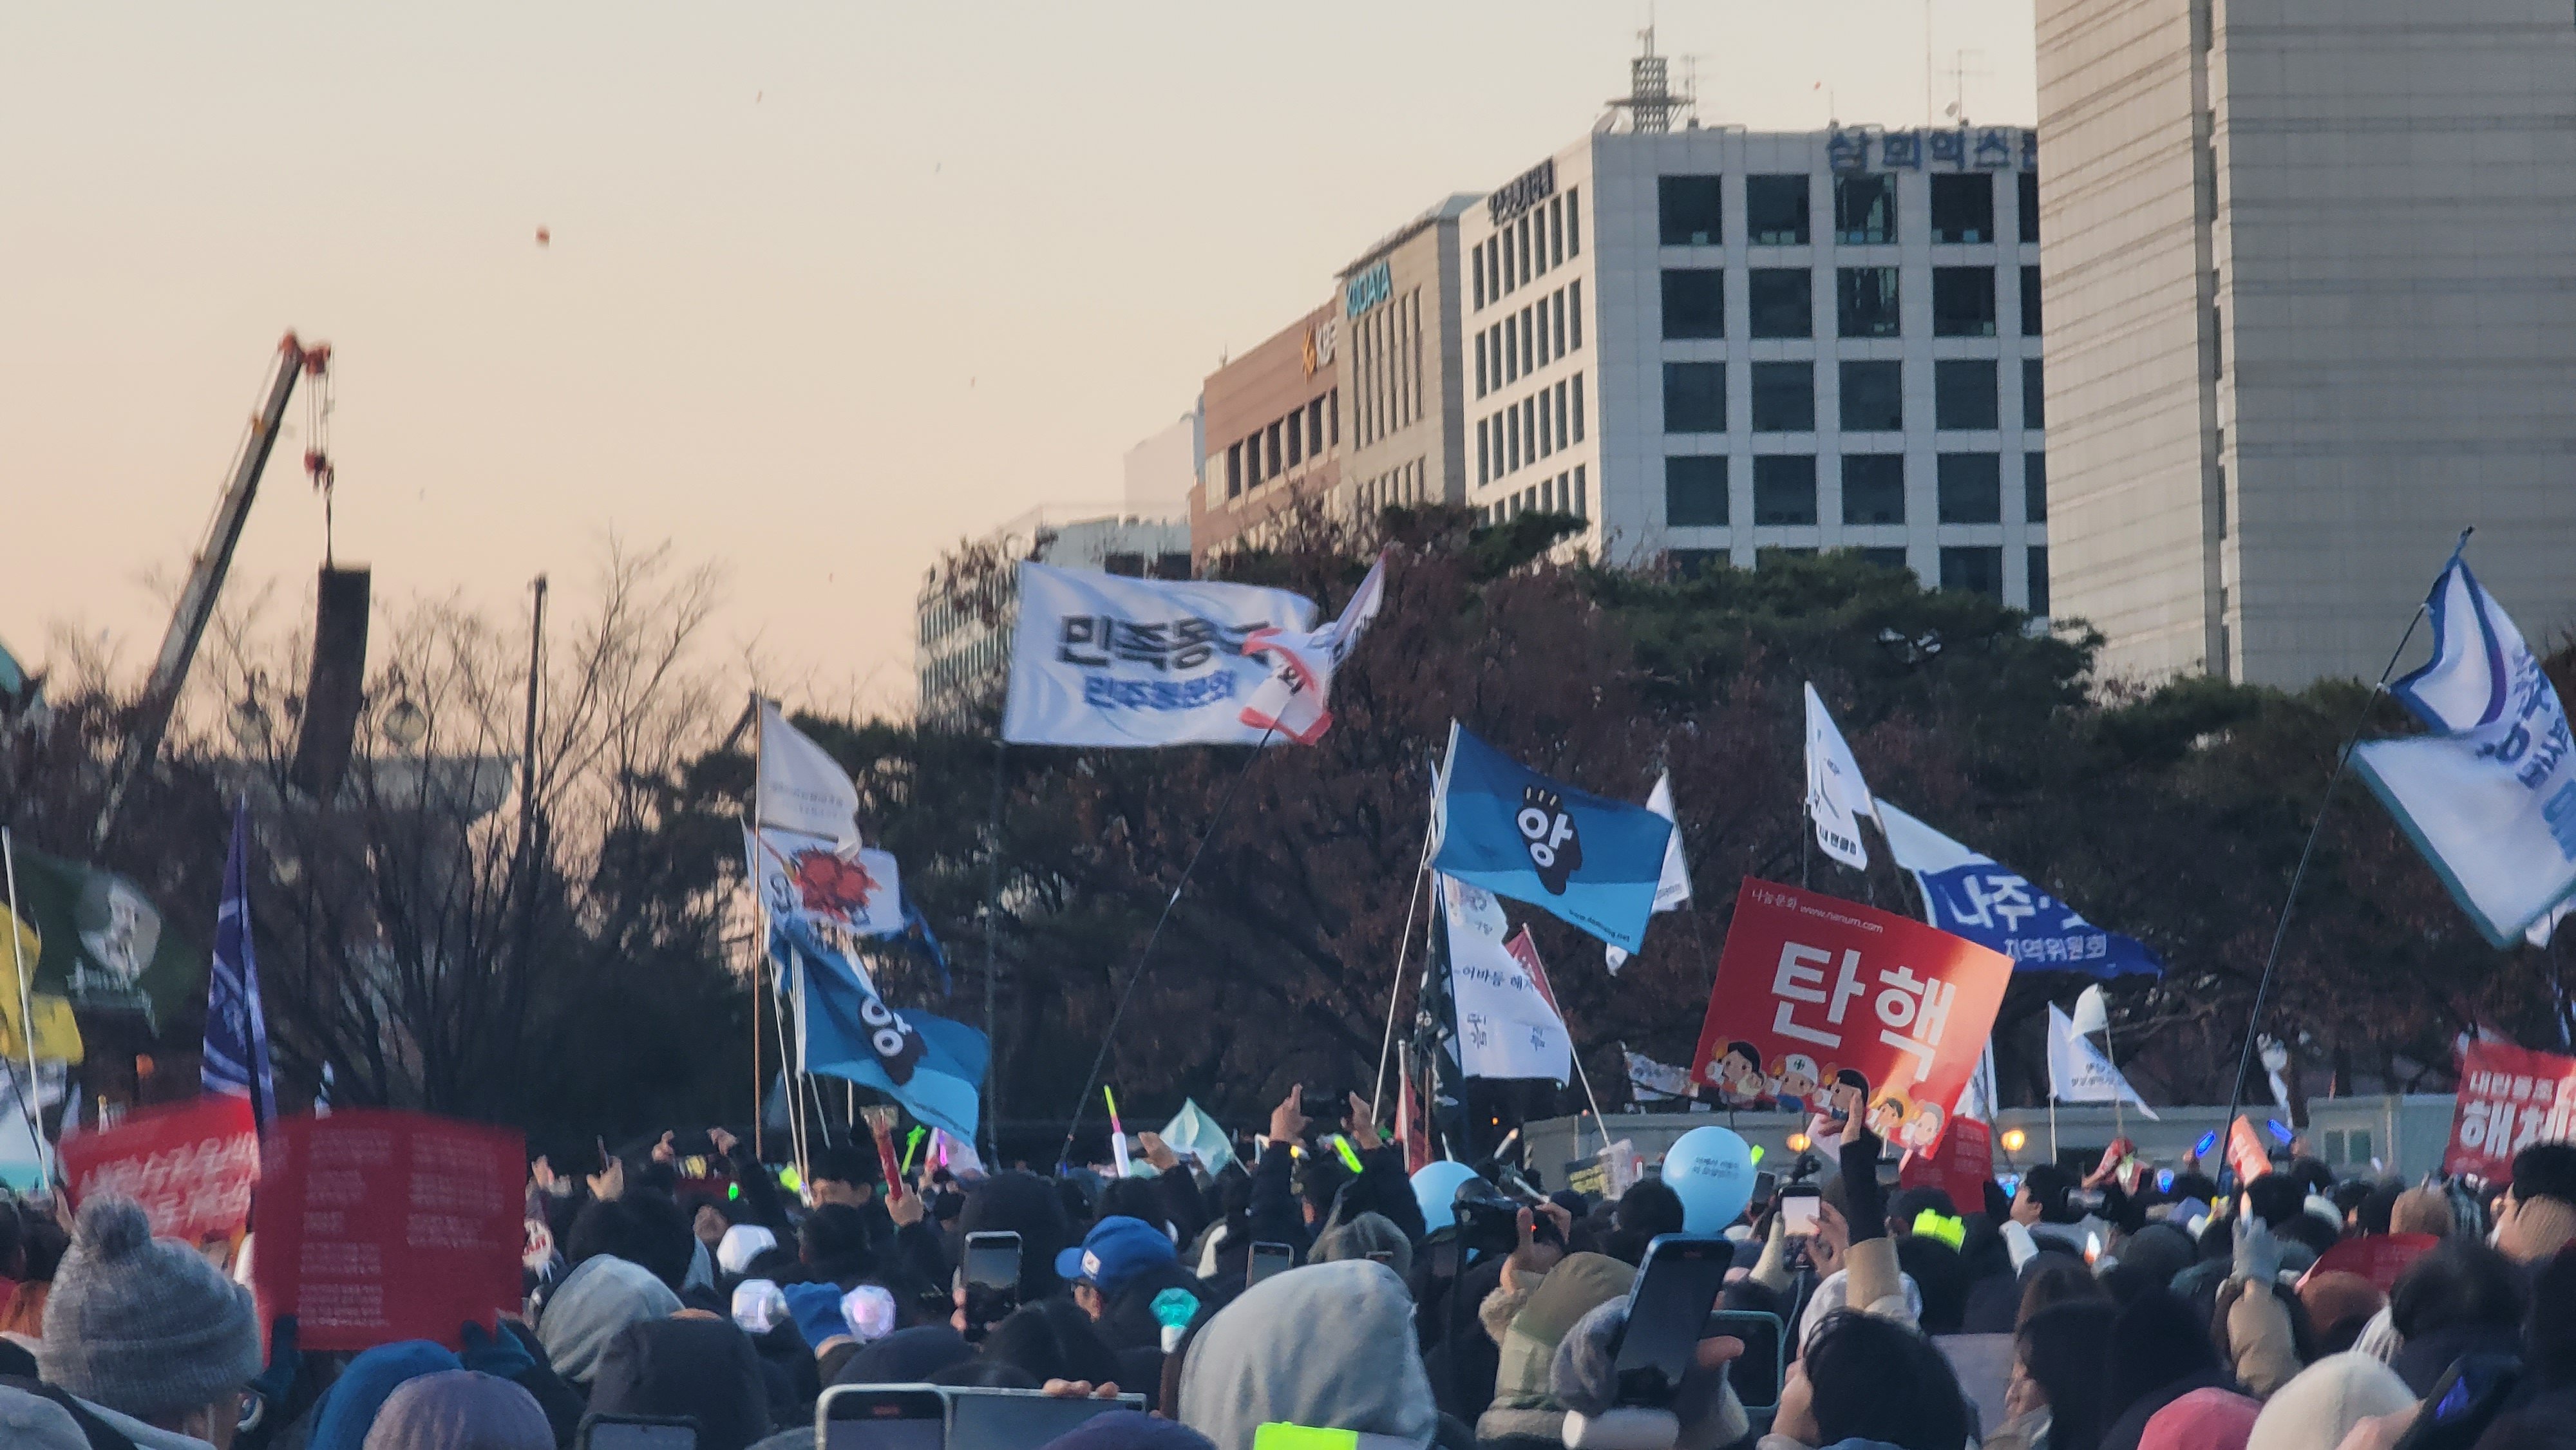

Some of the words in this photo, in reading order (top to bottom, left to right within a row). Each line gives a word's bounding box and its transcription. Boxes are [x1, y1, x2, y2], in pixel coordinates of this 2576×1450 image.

[1800, 905, 1884, 934] www.nanum.com
[1772, 941, 1956, 1082] 탄핵
[2461, 1099, 2576, 1159] 해체
